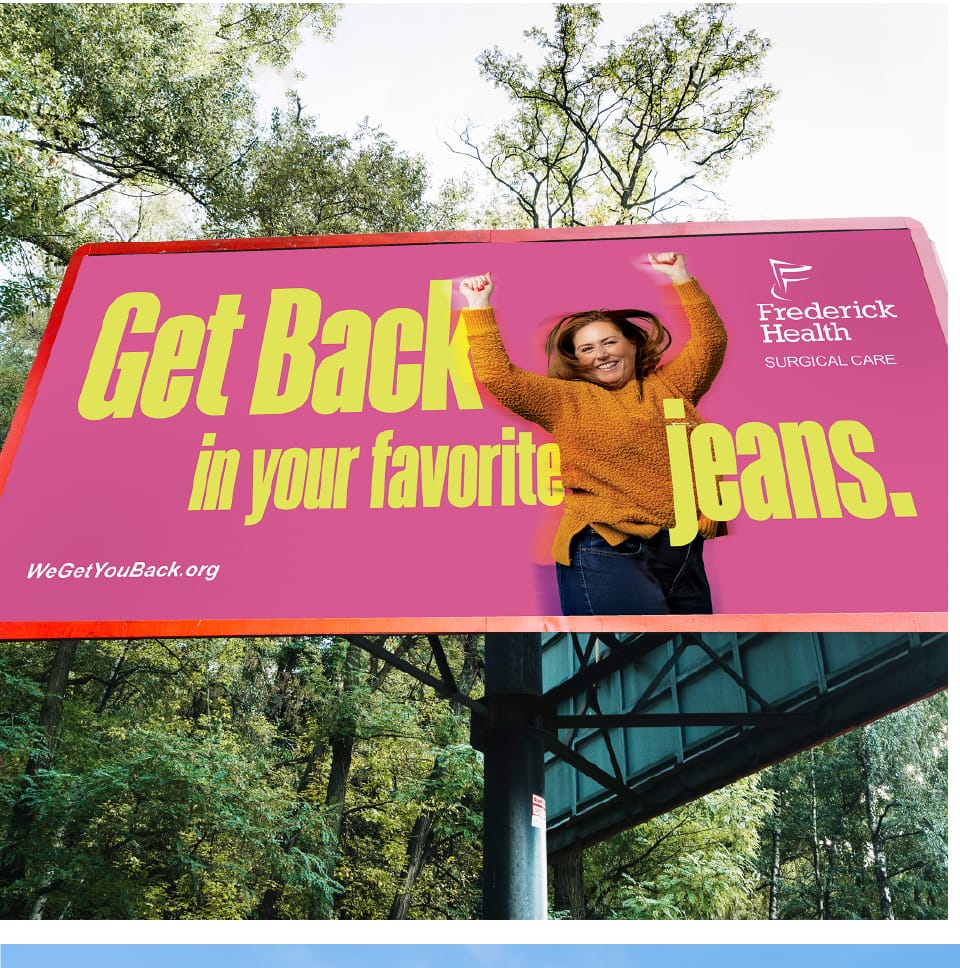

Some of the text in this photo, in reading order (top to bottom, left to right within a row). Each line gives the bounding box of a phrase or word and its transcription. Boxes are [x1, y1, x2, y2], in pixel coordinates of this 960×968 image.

[756, 300, 898, 321] Frederick
[760, 322, 852, 343] Health
[78, 279, 483, 420] Get Back
[764, 354, 897, 369] SURGICAL CARE
[188, 399, 919, 547] in your favorite jeans.
[26, 561, 221, 581] WeGetYouBack.org
